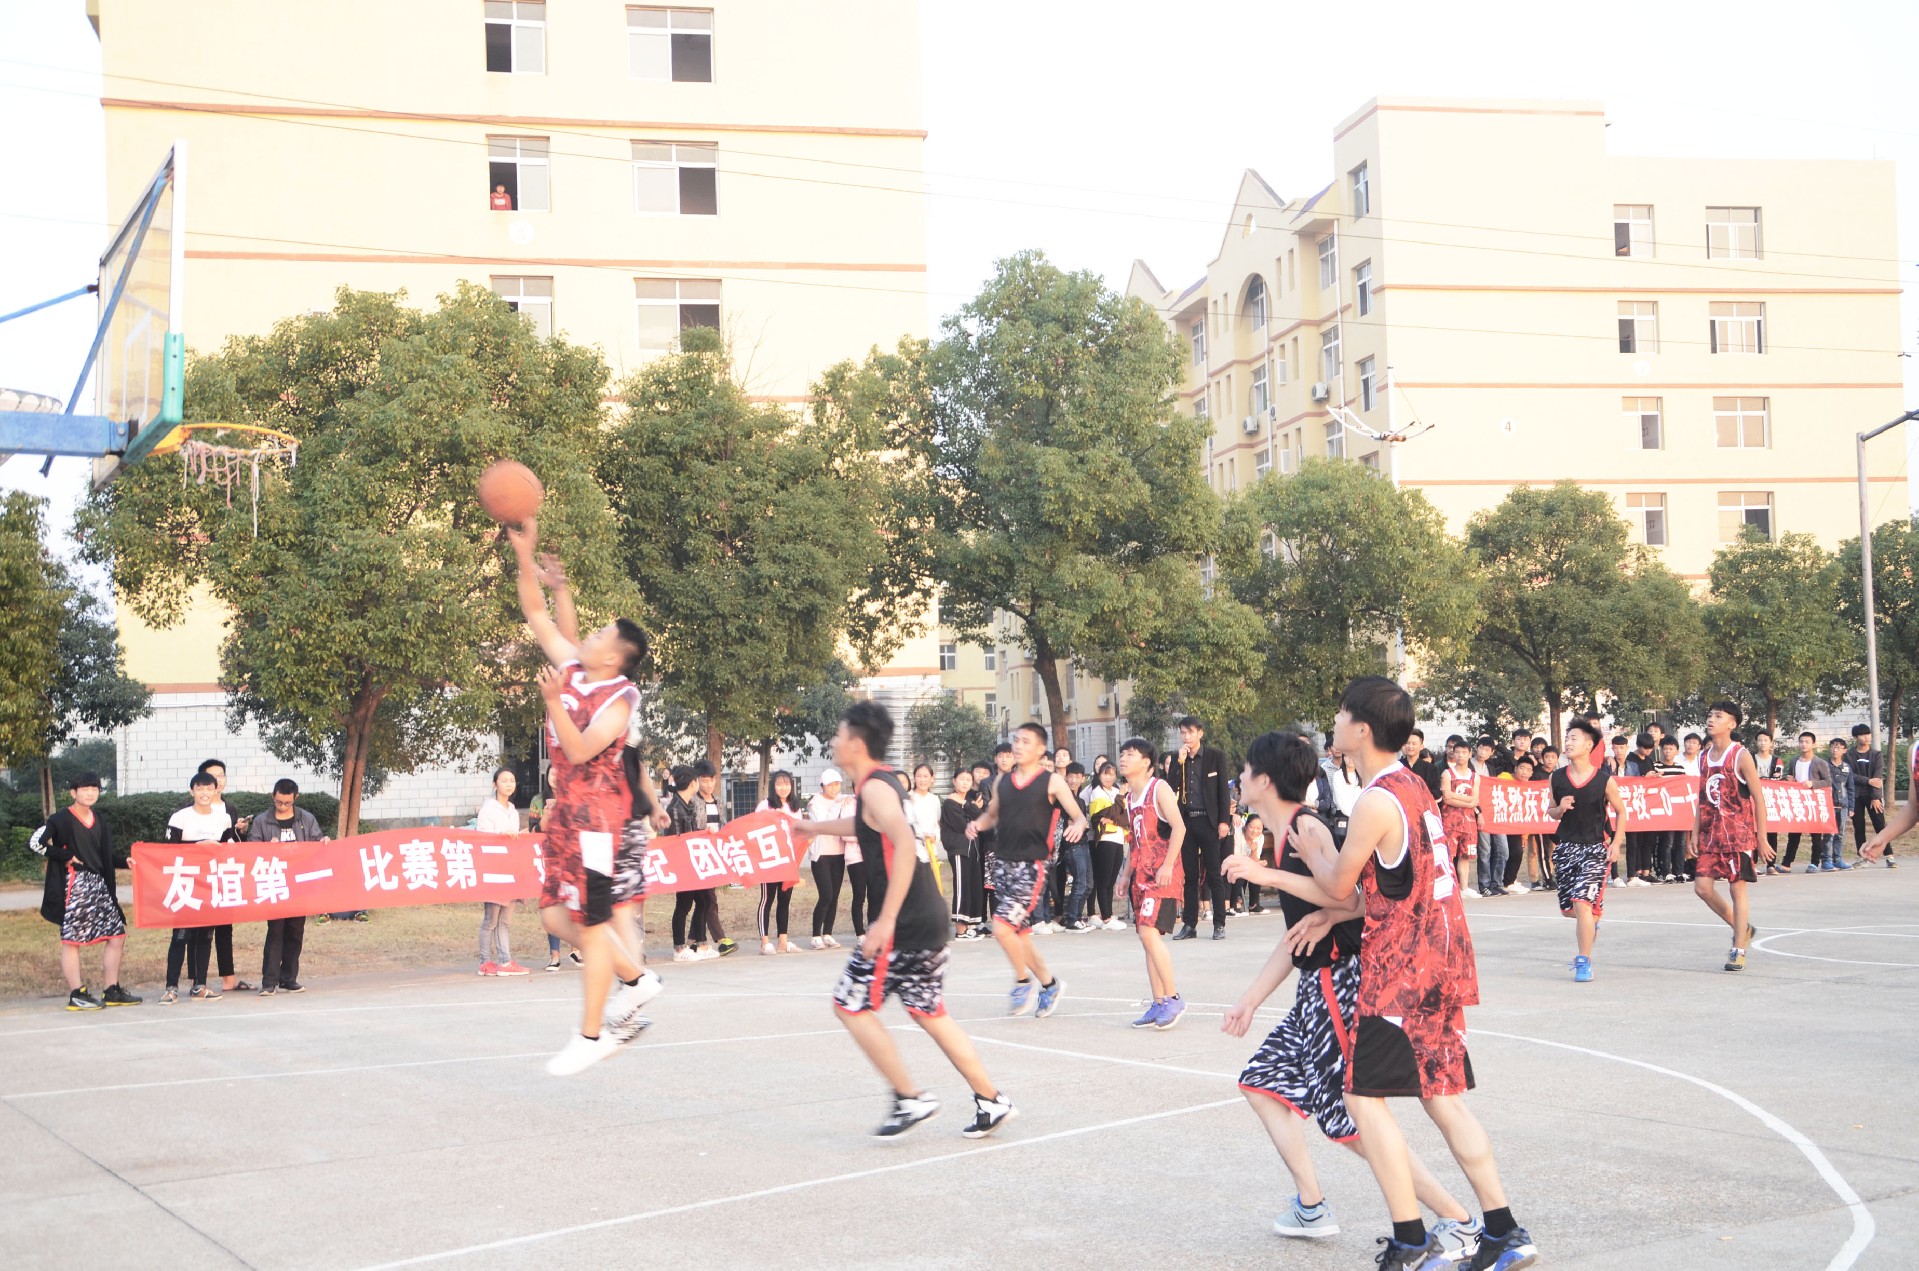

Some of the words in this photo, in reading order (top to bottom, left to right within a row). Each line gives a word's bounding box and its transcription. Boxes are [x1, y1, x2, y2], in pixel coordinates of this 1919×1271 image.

[162, 856, 333, 913] 友谊第一
[359, 838, 516, 893] 比赛第二
[685, 819, 796, 881] 团结互
[1467, 844, 1478, 856] 15
